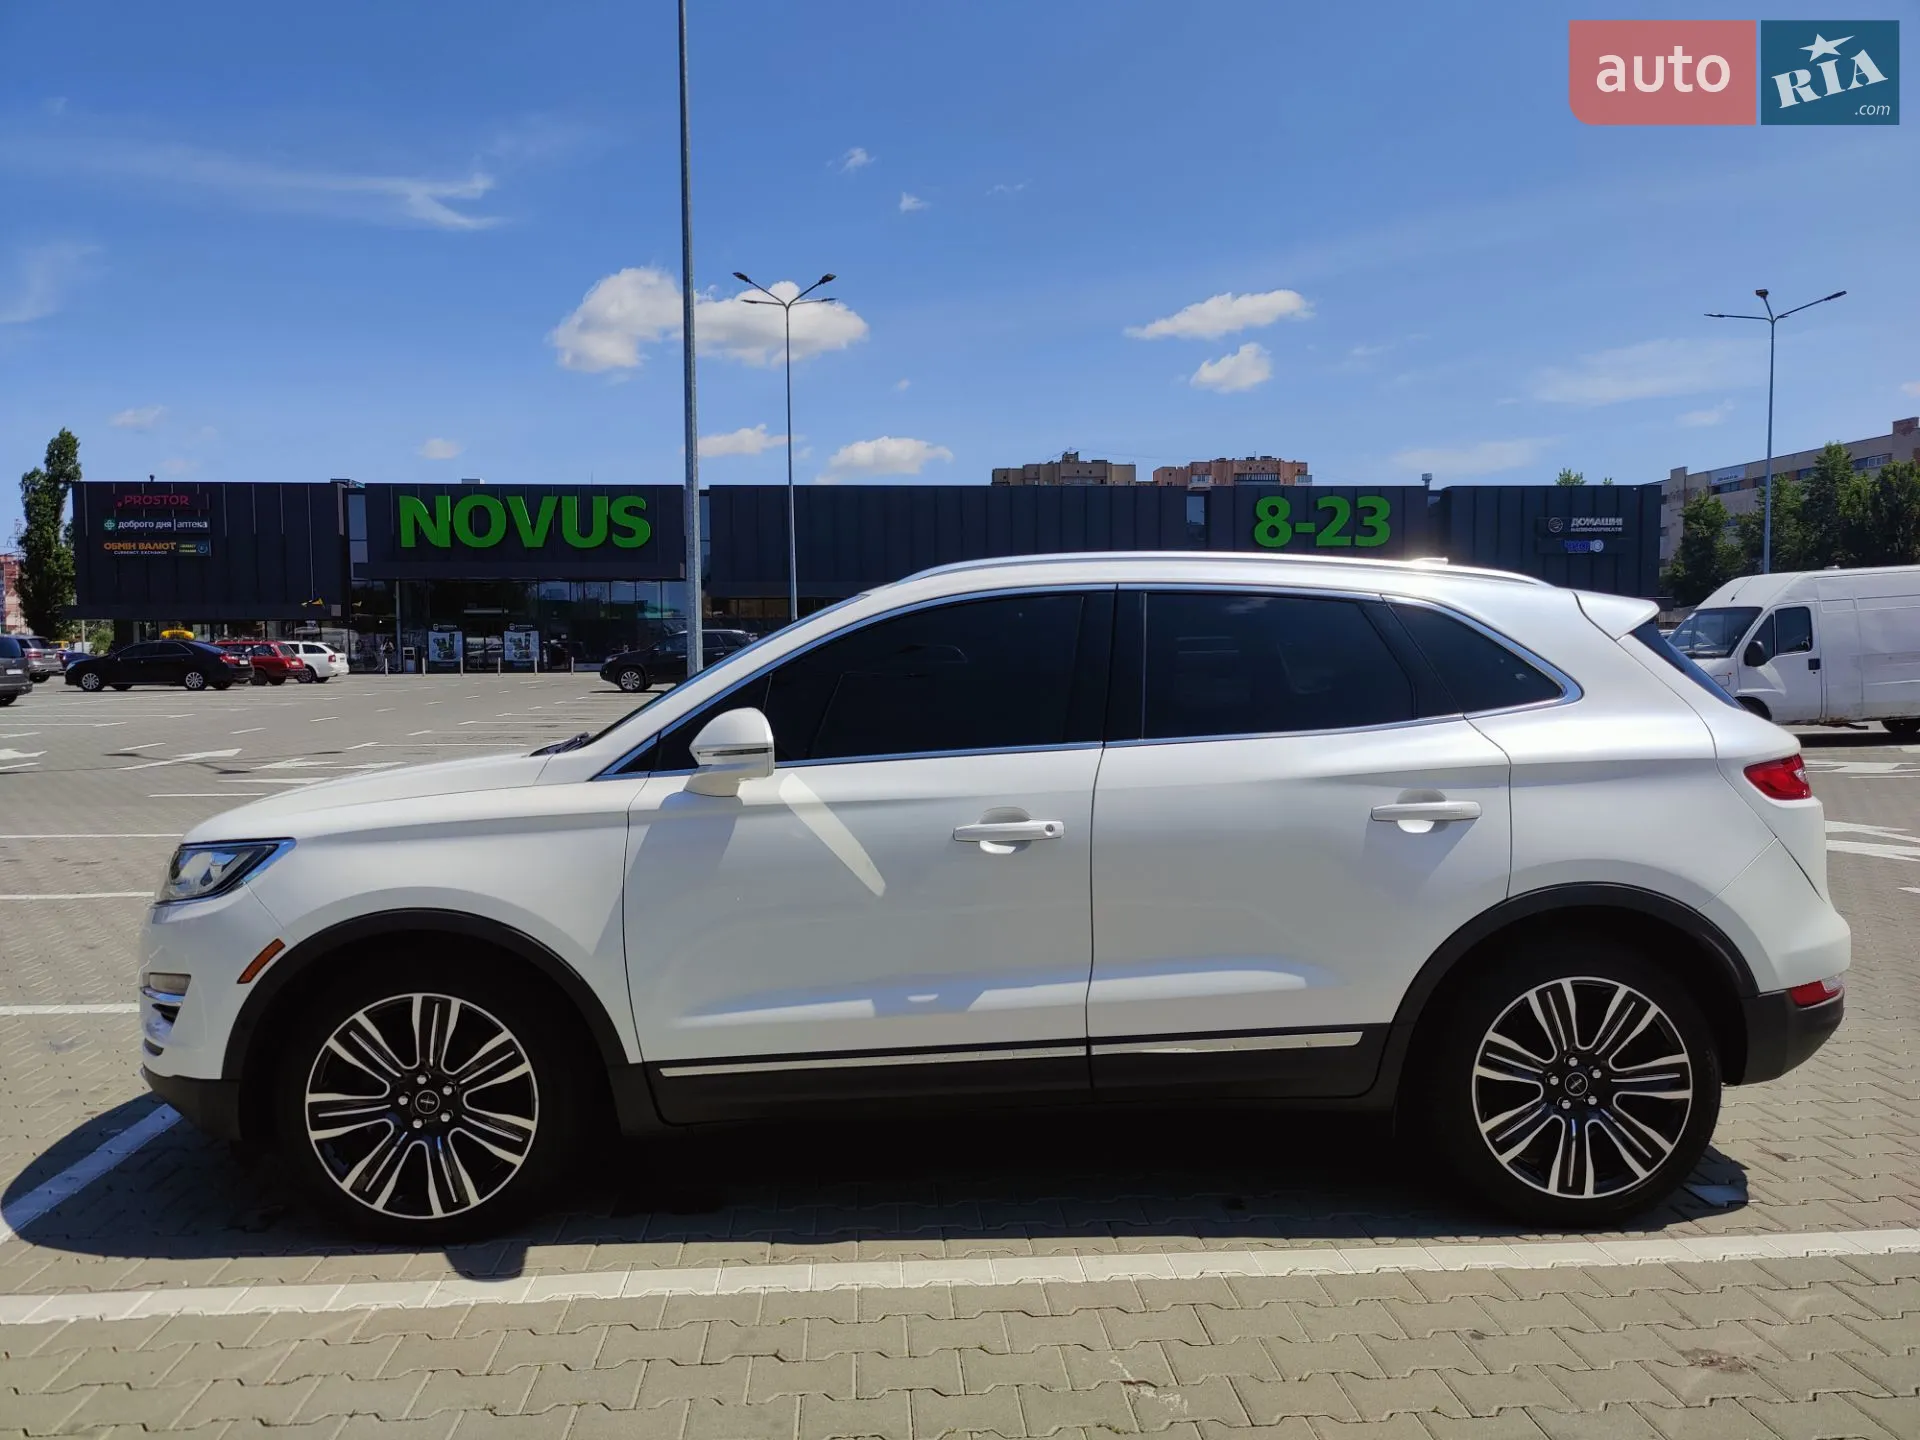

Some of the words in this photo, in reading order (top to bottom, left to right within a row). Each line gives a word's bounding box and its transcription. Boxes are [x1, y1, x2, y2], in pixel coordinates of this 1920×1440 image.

[124, 495, 190, 506] PROSTOR
[117, 520, 154, 530] доброго
[155, 521, 172, 530] дня
[176, 521, 208, 529] аптека
[399, 494, 651, 549] NOVUS
[1253, 495, 1392, 548] 8-23
[103, 542, 135, 551] ОБМІН
[138, 542, 177, 551] ВАЛЮТ
